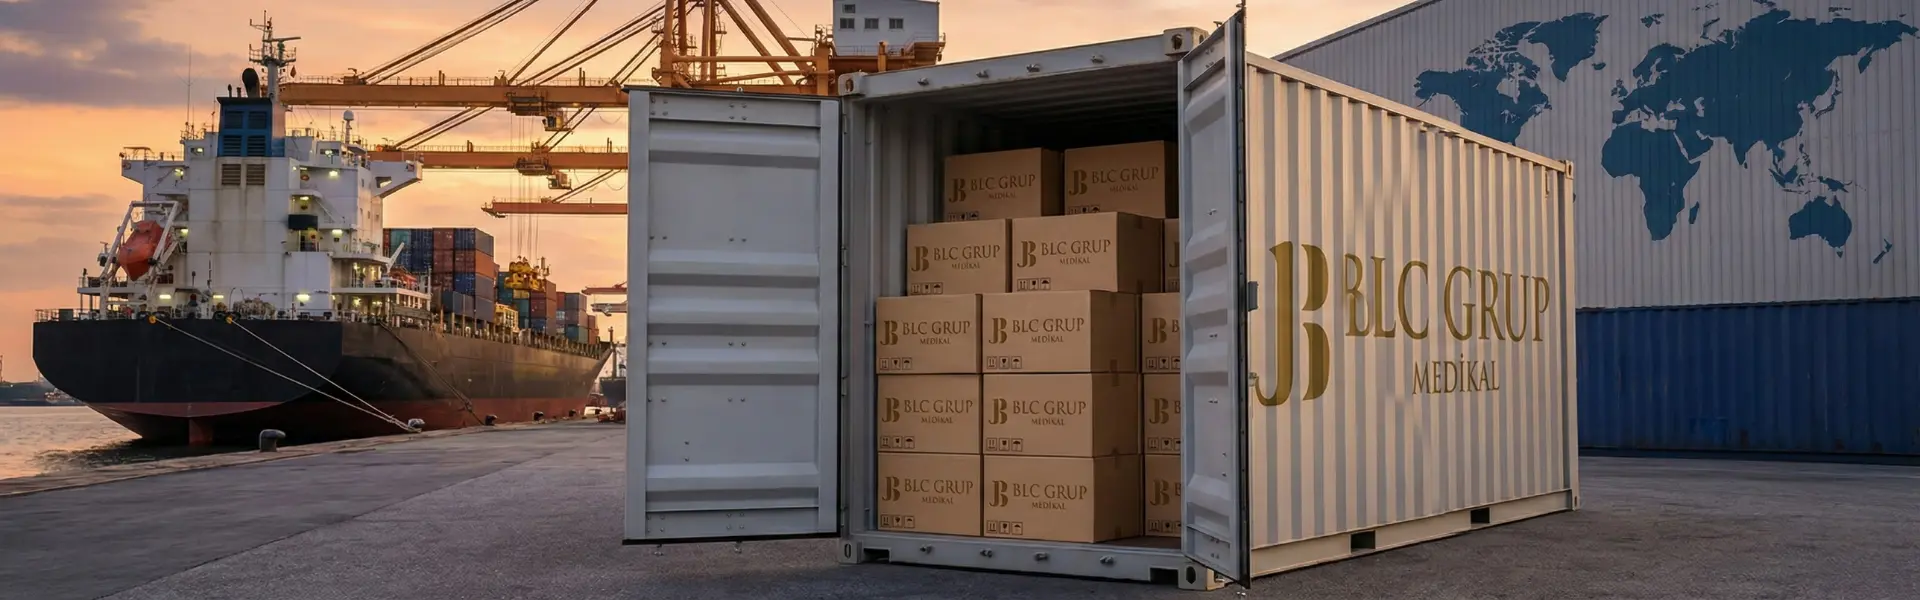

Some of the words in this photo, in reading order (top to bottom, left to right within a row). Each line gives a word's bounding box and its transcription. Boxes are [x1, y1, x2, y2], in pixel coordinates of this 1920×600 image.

[970, 178, 996, 191] BLC
[999, 174, 1036, 189] GRUP
[1092, 170, 1118, 184] BLC
[1120, 167, 1159, 182] GRUP
[934, 247, 958, 260] BLC
[963, 245, 1001, 259] GRUP
[1041, 242, 1067, 255] BLC
[1072, 240, 1111, 253] GRUP
[1345, 253, 1429, 340] BLC
[1444, 266, 1550, 341] GRUP
[902, 322, 929, 335] BLC
[931, 321, 970, 334] GRUP
[1012, 319, 1038, 333] BLC
[1042, 318, 1084, 332] GRUP
[1413, 354, 1500, 395] MEDİKAL
[904, 400, 929, 413] BLC
[933, 400, 973, 414] GRUP
[1013, 401, 1039, 415] BLC
[1043, 401, 1086, 415] GRUP
[904, 479, 930, 493] BLC
[934, 480, 973, 494] GRUP
[1013, 484, 1039, 497] BLC
[1045, 485, 1087, 500] GRUP
